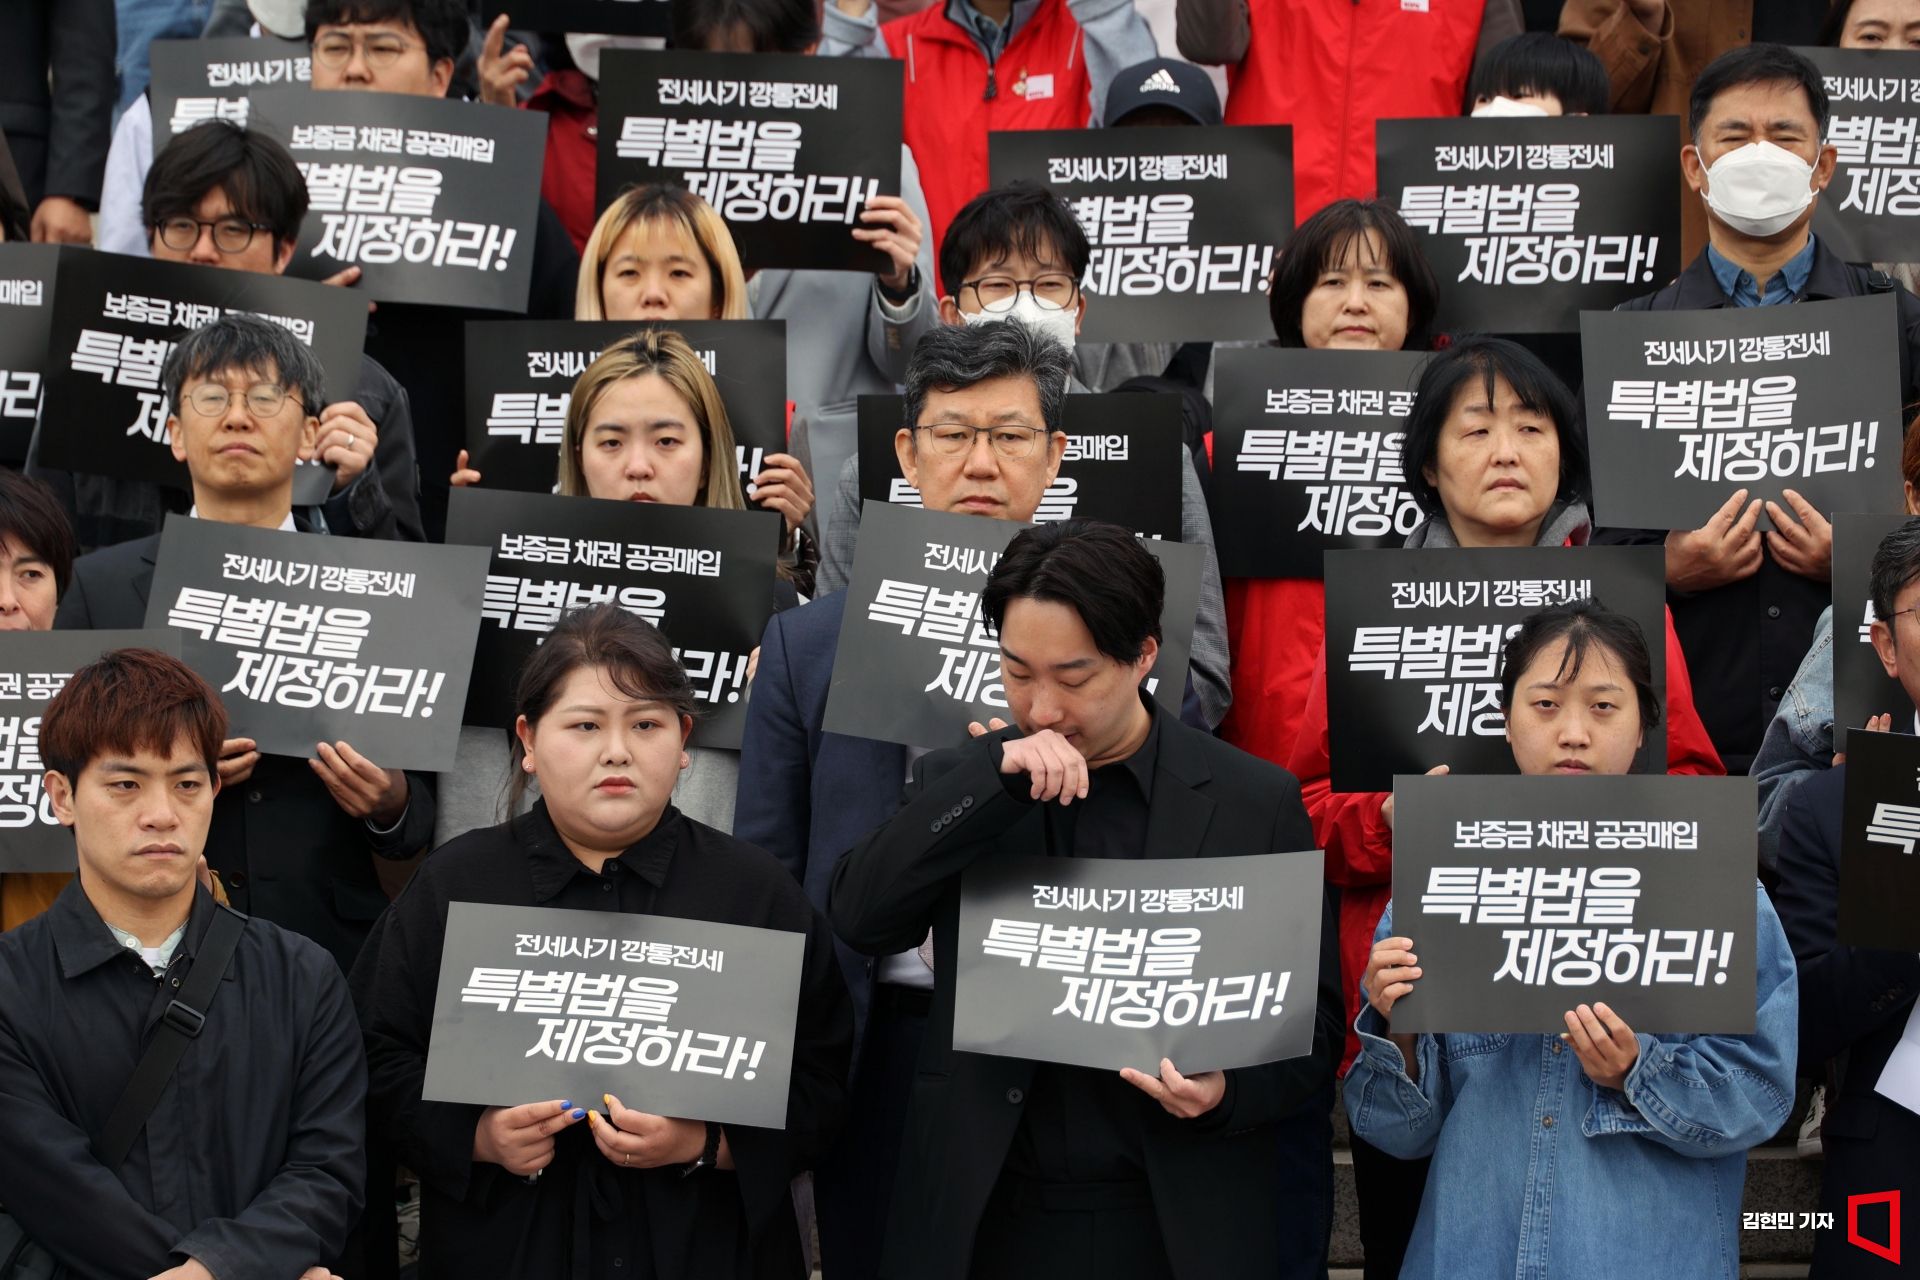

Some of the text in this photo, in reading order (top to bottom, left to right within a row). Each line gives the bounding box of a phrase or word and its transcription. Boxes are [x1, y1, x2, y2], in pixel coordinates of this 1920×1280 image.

[207, 58, 293, 87] 전세사기
[658, 79, 839, 110] 전세사기 깡통전세
[1822, 76, 1907, 103] 전세사기
[290, 125, 496, 163] 보증금 채권 공공매입
[616, 116, 802, 172] 특별법을
[1435, 143, 1615, 171] 전세사기 깡통전세
[1827, 115, 1920, 165] 별법
[300, 163, 443, 215] 별법을
[1048, 154, 1228, 184] 전세사기 깡통전세
[1397, 183, 1581, 235] 특별법을
[311, 214, 518, 271] 제정하라!
[1458, 235, 1660, 285] 제정하라!
[1082, 244, 1274, 297] 제정하라!
[103, 292, 172, 327] 보증금
[71, 329, 177, 391] 특별
[1644, 331, 1831, 366] 전세사기 깡통전세
[1264, 389, 1335, 415] 보증금
[1337, 389, 1384, 415] 채권
[1606, 375, 1798, 430] 특별법을
[1061, 434, 1129, 461] 공매입
[1674, 420, 1880, 482] 제정하라!
[222, 552, 417, 599] 전세사기 깡통전세
[497, 533, 722, 577] 보증금 채권 공공매입
[1391, 579, 1592, 609] 전세사기 깡통전세
[167, 586, 372, 659] 특별법을
[1348, 624, 1521, 680] 특별법
[222, 650, 446, 718] 제정하라!
[1453, 820, 1699, 850] 보증금 채권 공공매입
[1032, 884, 1244, 914] 전세사기 깡통전세
[1420, 866, 1642, 925] 특별법을
[514, 933, 725, 973] 전세사기 깡통전세
[982, 918, 1202, 977] 특별법을
[1493, 928, 1735, 987] 제정하라!
[461, 967, 680, 1023] 특별법을
[1052, 971, 1292, 1029] 제정하라!
[525, 1018, 767, 1081] 제정하라!
